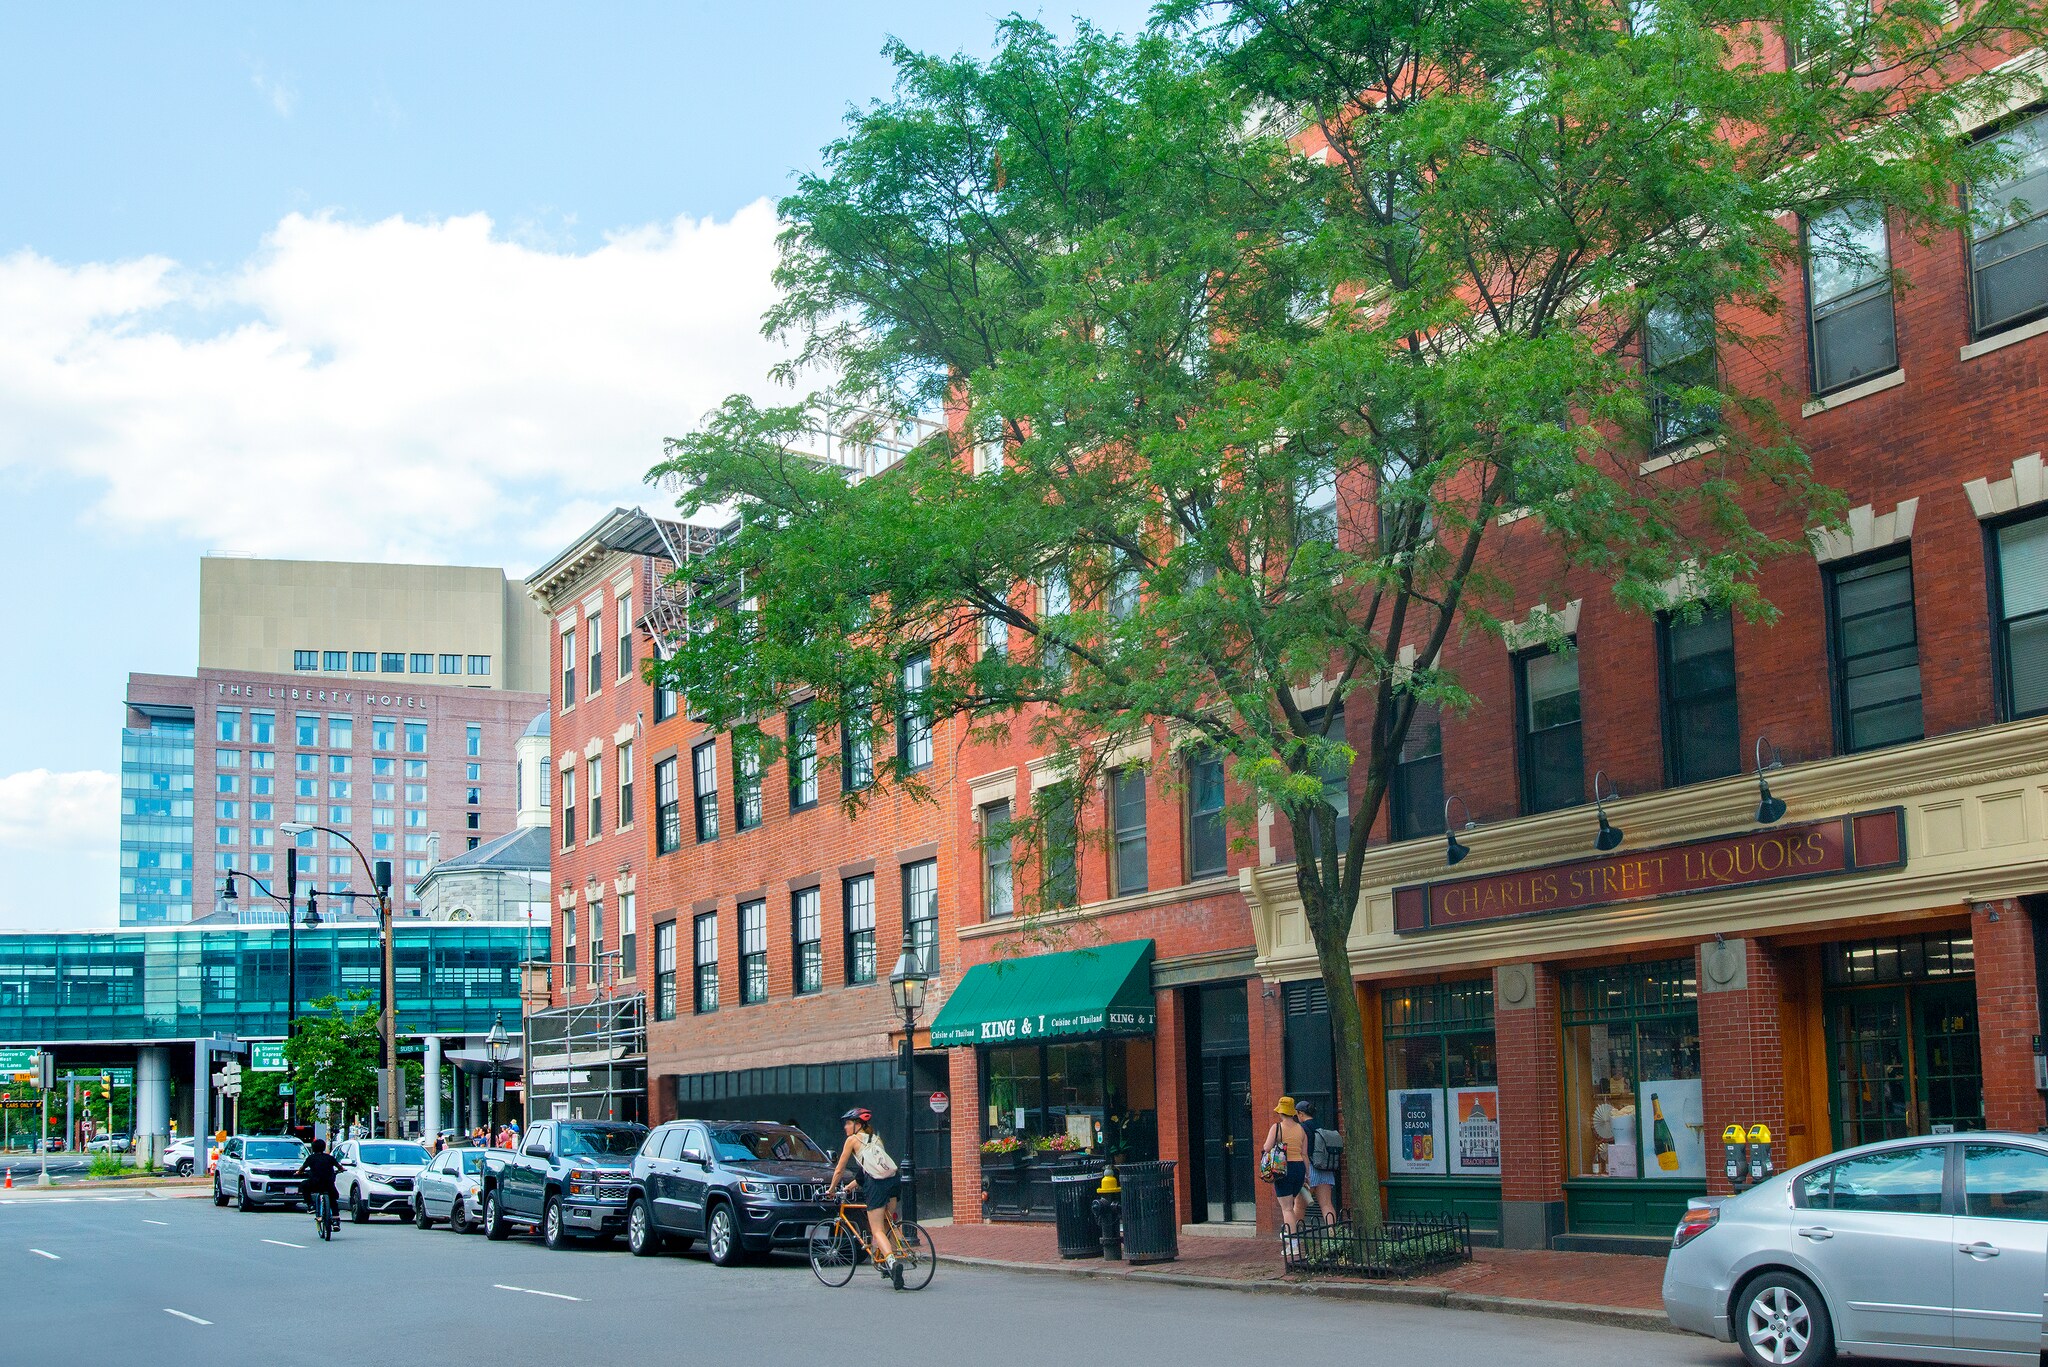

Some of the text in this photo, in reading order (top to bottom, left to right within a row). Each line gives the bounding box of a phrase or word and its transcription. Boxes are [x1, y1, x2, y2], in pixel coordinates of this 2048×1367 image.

[217, 683, 427, 709] THE LIBERTY HOTEL
[1443, 832, 1825, 917] CHARLES STREET LIQUORS
[931, 1013, 1103, 1039] Cuisine of Thailand KING & I Cuisine of Thailand
[1109, 1013, 1154, 1024] KING & I
